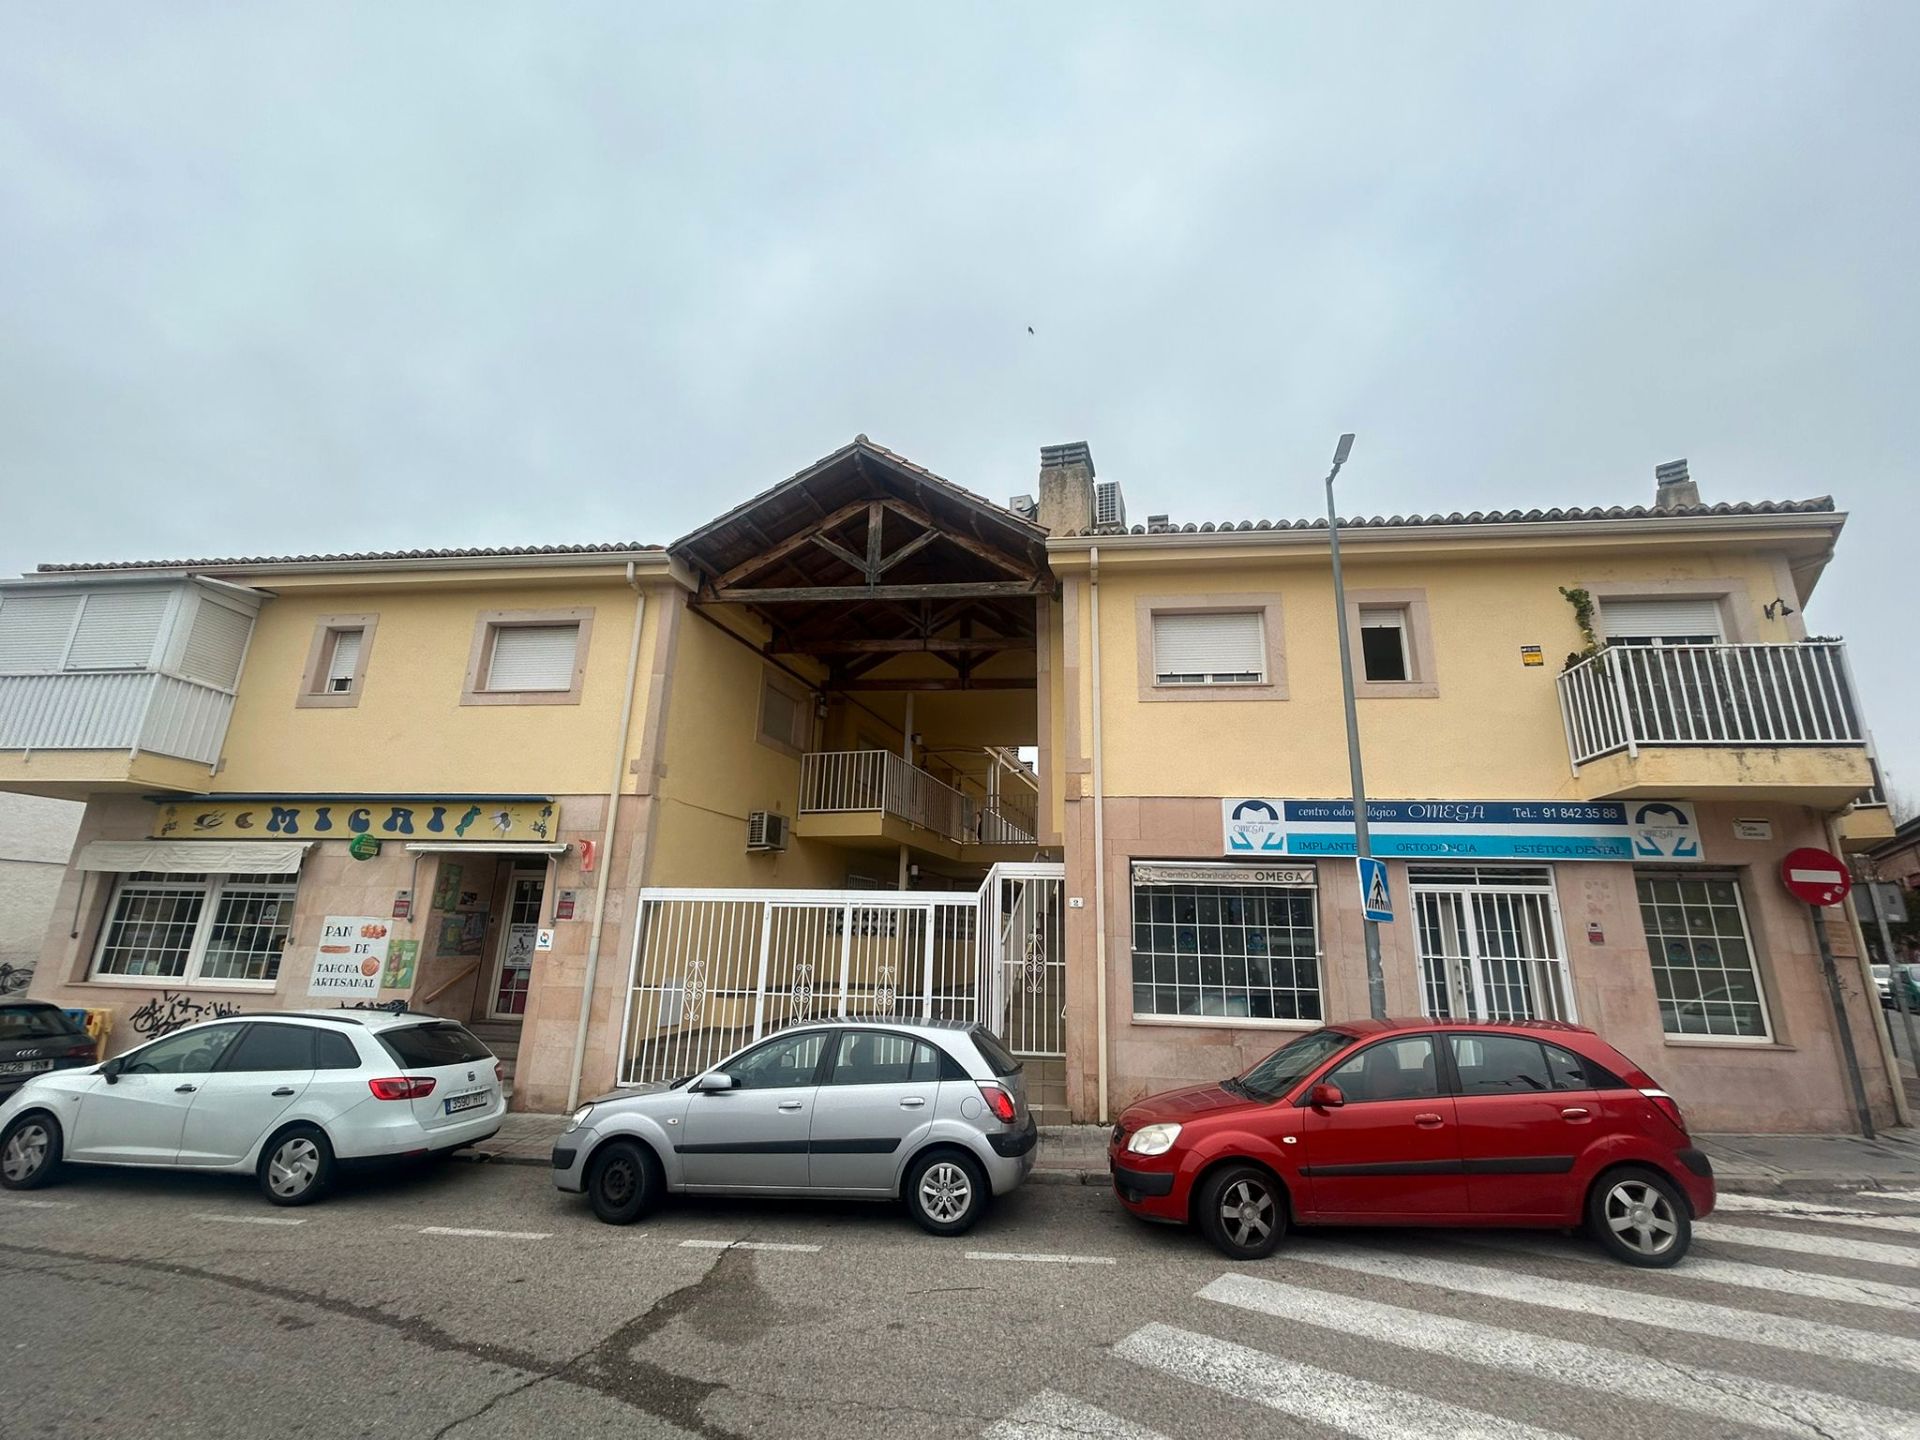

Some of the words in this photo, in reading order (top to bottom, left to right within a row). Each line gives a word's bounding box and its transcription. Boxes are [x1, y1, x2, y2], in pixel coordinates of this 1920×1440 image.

[1298, 806, 1330, 817] centro
[1333, 804, 1397, 820] odológico
[1408, 804, 1485, 822] OMEGA
[1513, 807, 1537, 818] Tel.:
[1543, 808, 1556, 818] 91
[1561, 808, 1582, 819] 842
[1585, 808, 1600, 819] 35
[1603, 809, 1618, 819] 88
[1514, 843, 1573, 854] ESTÉTICA
[1575, 845, 1625, 855] DENTAL
[1160, 870, 1189, 879] Centro
[1255, 871, 1304, 882] OMEGA
[325, 926, 353, 937] PAN
[354, 943, 370, 954] DE
[317, 963, 359, 974] TAHONA
[312, 977, 375, 988] ARTESANAL
